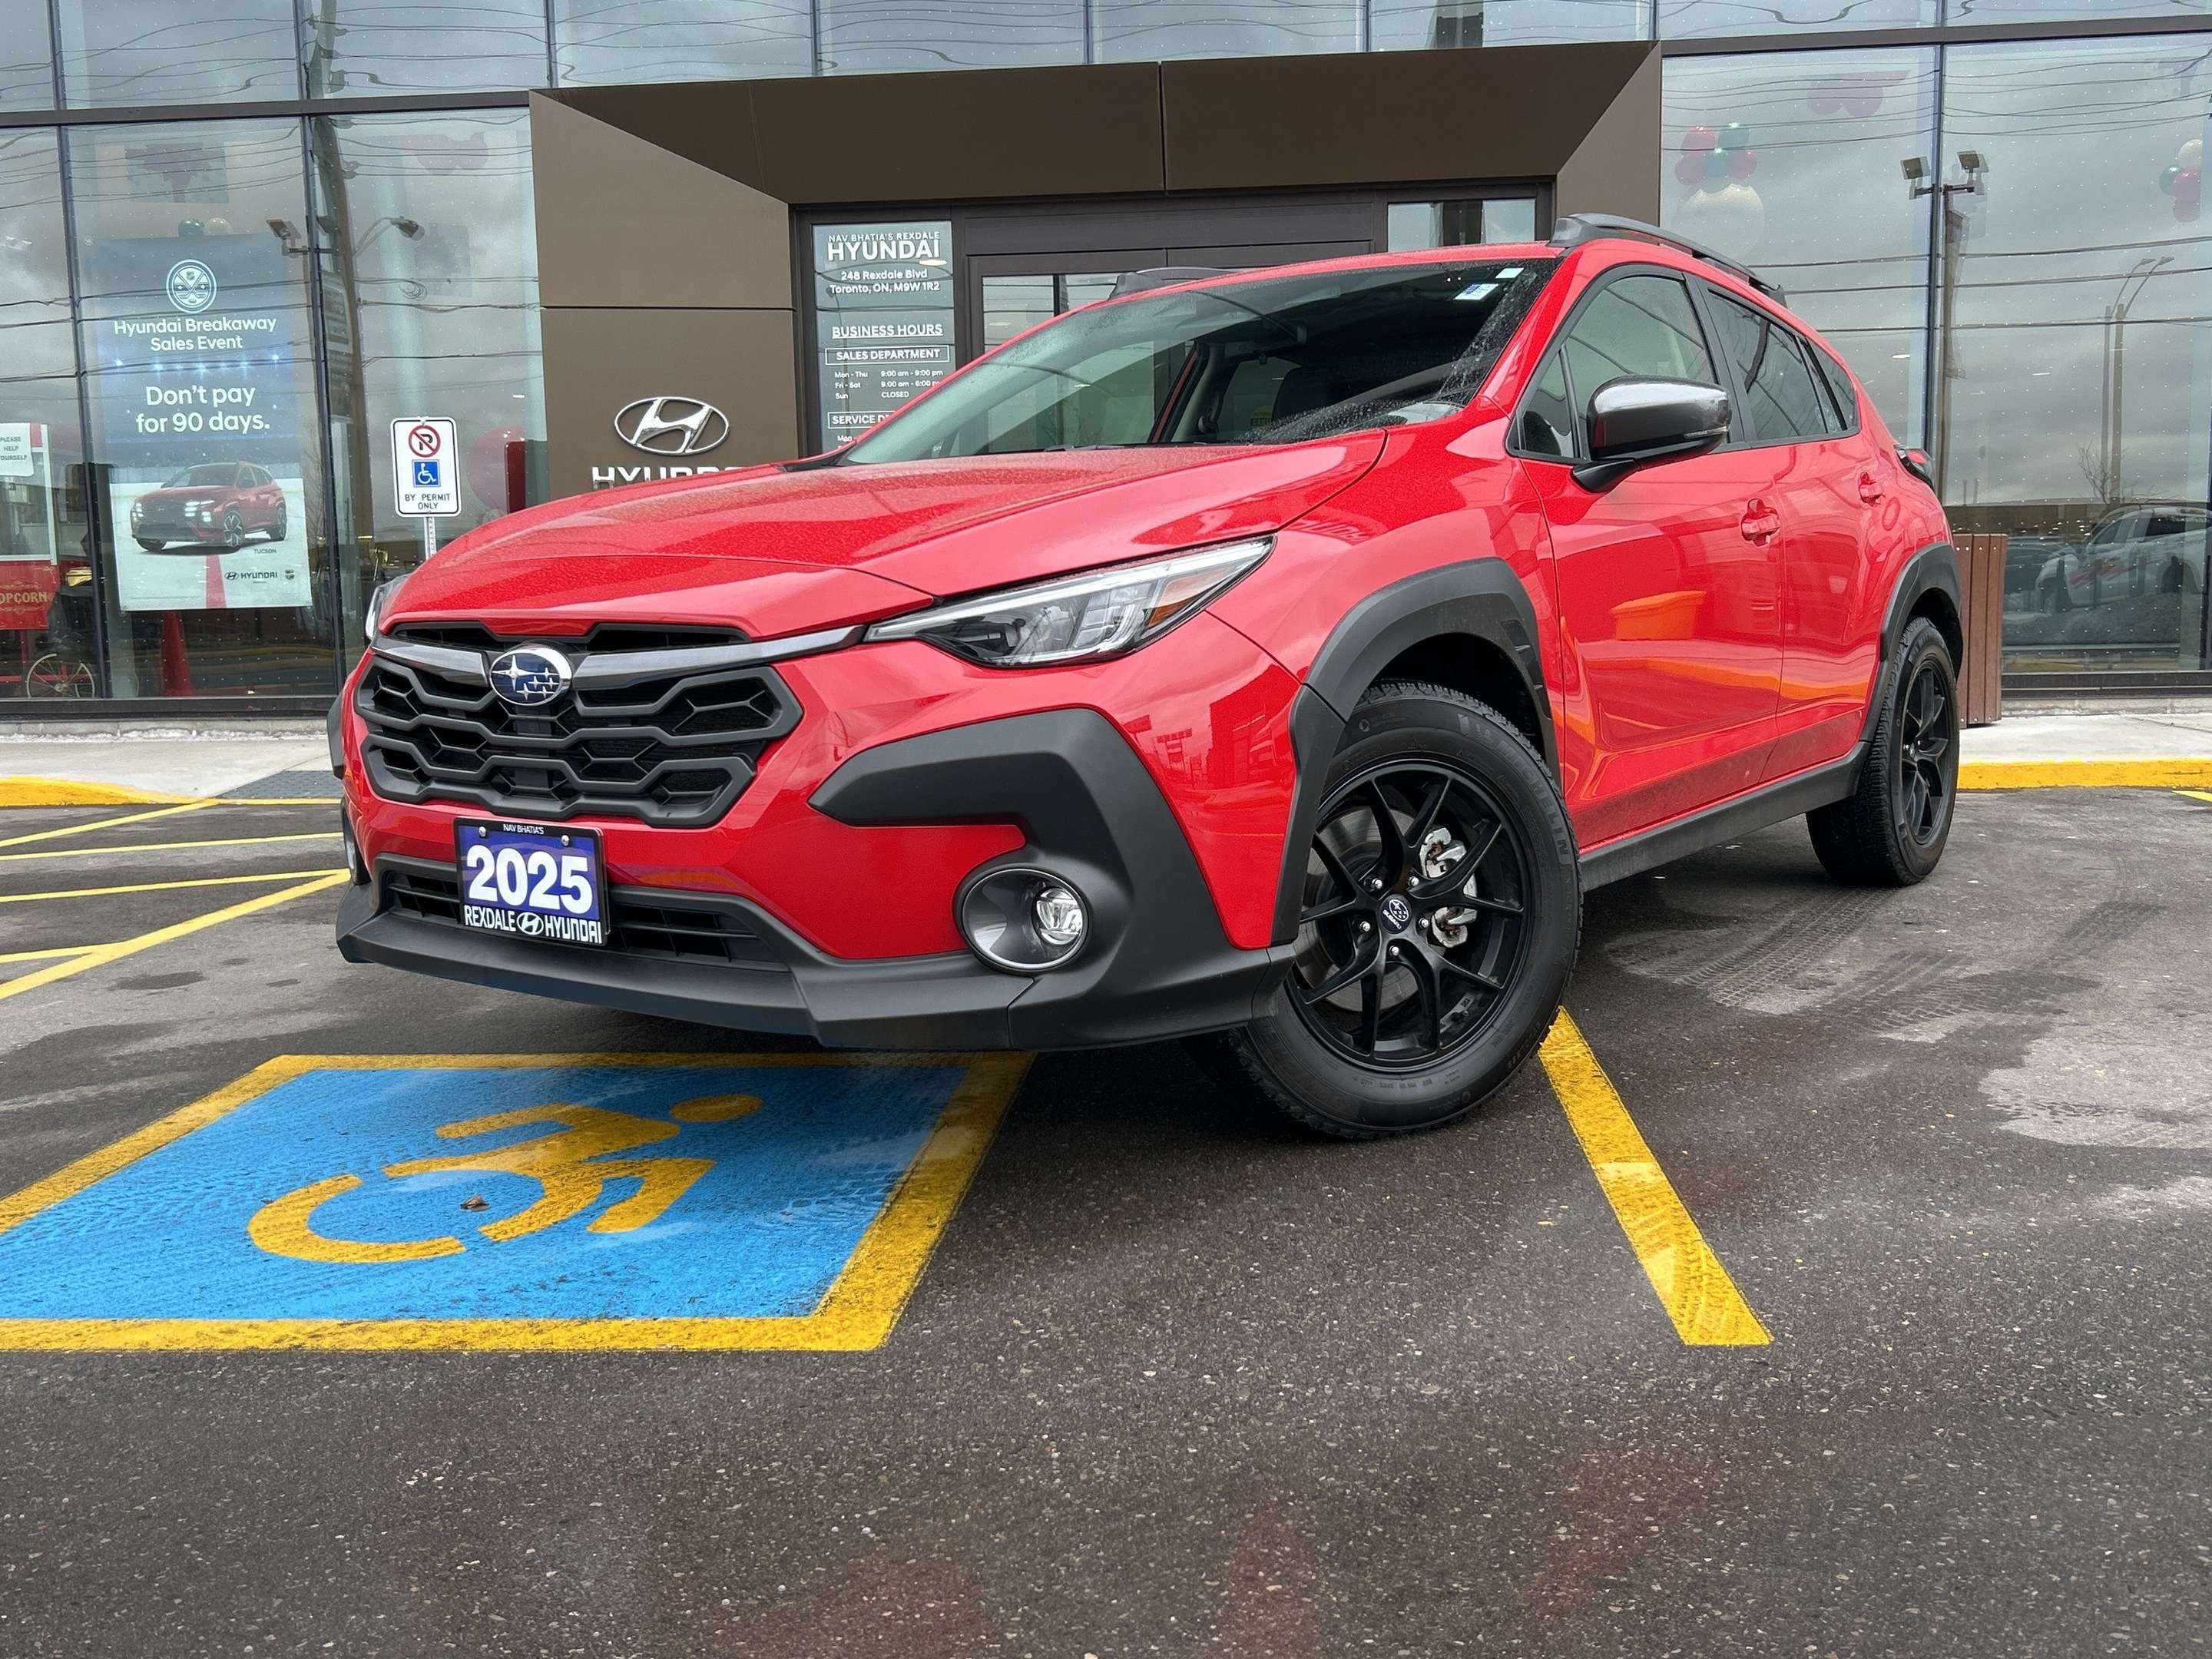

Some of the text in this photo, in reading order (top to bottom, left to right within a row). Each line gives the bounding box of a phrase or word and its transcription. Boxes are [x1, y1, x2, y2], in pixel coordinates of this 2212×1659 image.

[829, 231, 940, 243] NAV BHATIA'S REXDALE
[828, 239, 940, 261] HYUNDAI
[841, 269, 928, 281] 248 Rexdale Blvd
[830, 281, 940, 294] Toronto, ON, M9W 1R2
[114, 316, 276, 338] Hyundai Breakaway
[832, 323, 943, 338] BUSINESS HOURS
[151, 335, 243, 351] Sales Event
[836, 349, 941, 361] SALES DEPARTMENT
[146, 385, 256, 408] Don't pay
[136, 411, 270, 435] for 90 days.
[832, 414, 876, 425] SERVICE
[422, 493, 451, 502] PERMIT
[503, 823, 545, 835] NAV BHATIA'S
[466, 844, 594, 915] 2025
[464, 905, 603, 945] REXDALE HYUNDAI
[1382, 909, 1402, 929] SUBARU
